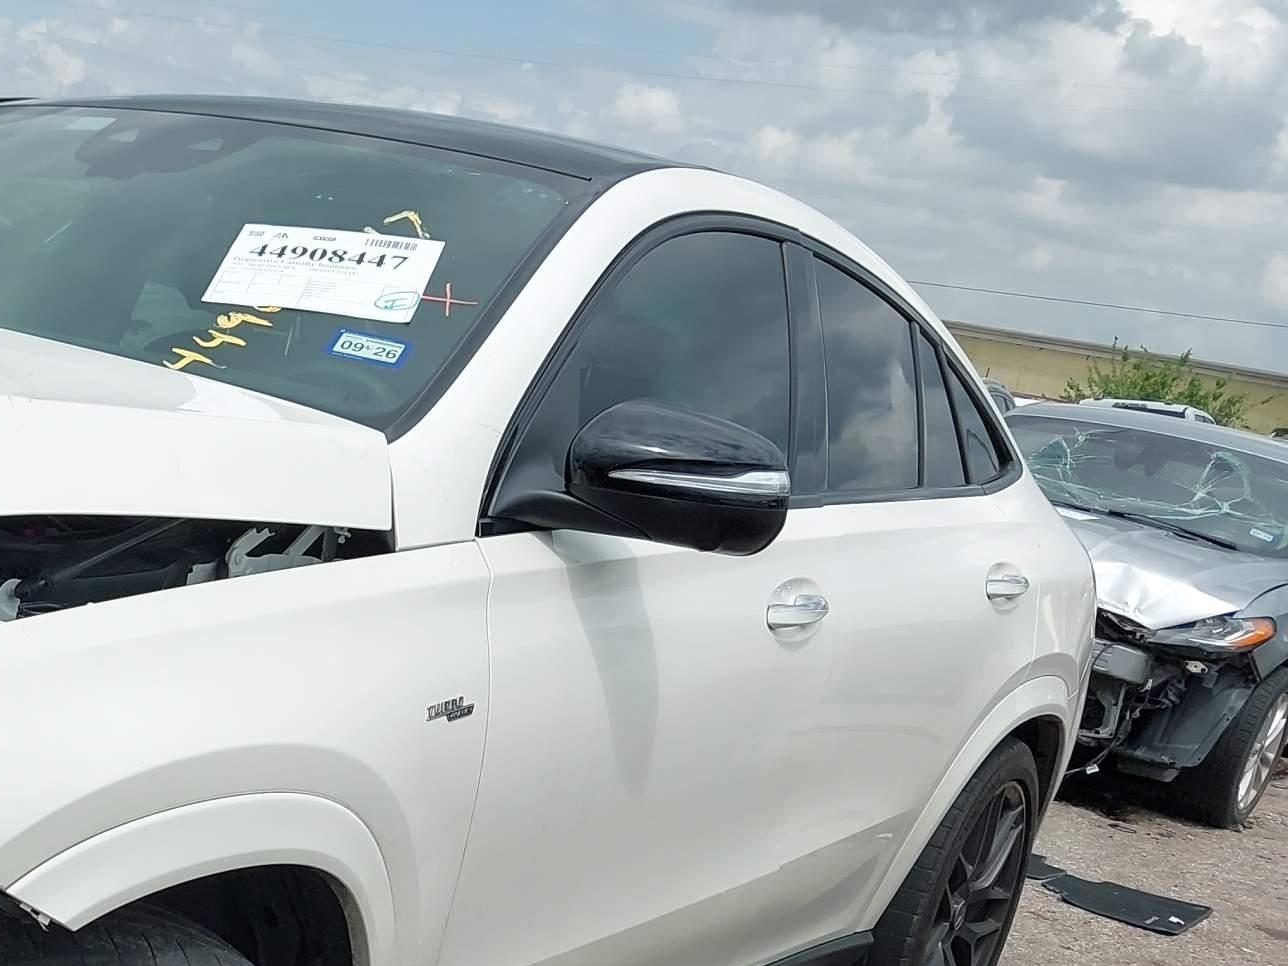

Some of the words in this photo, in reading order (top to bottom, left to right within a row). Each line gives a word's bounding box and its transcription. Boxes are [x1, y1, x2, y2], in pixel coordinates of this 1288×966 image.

[249, 244, 409, 270] 44908447
[340, 340, 365, 352] 09
[372, 346, 399, 359] 26
